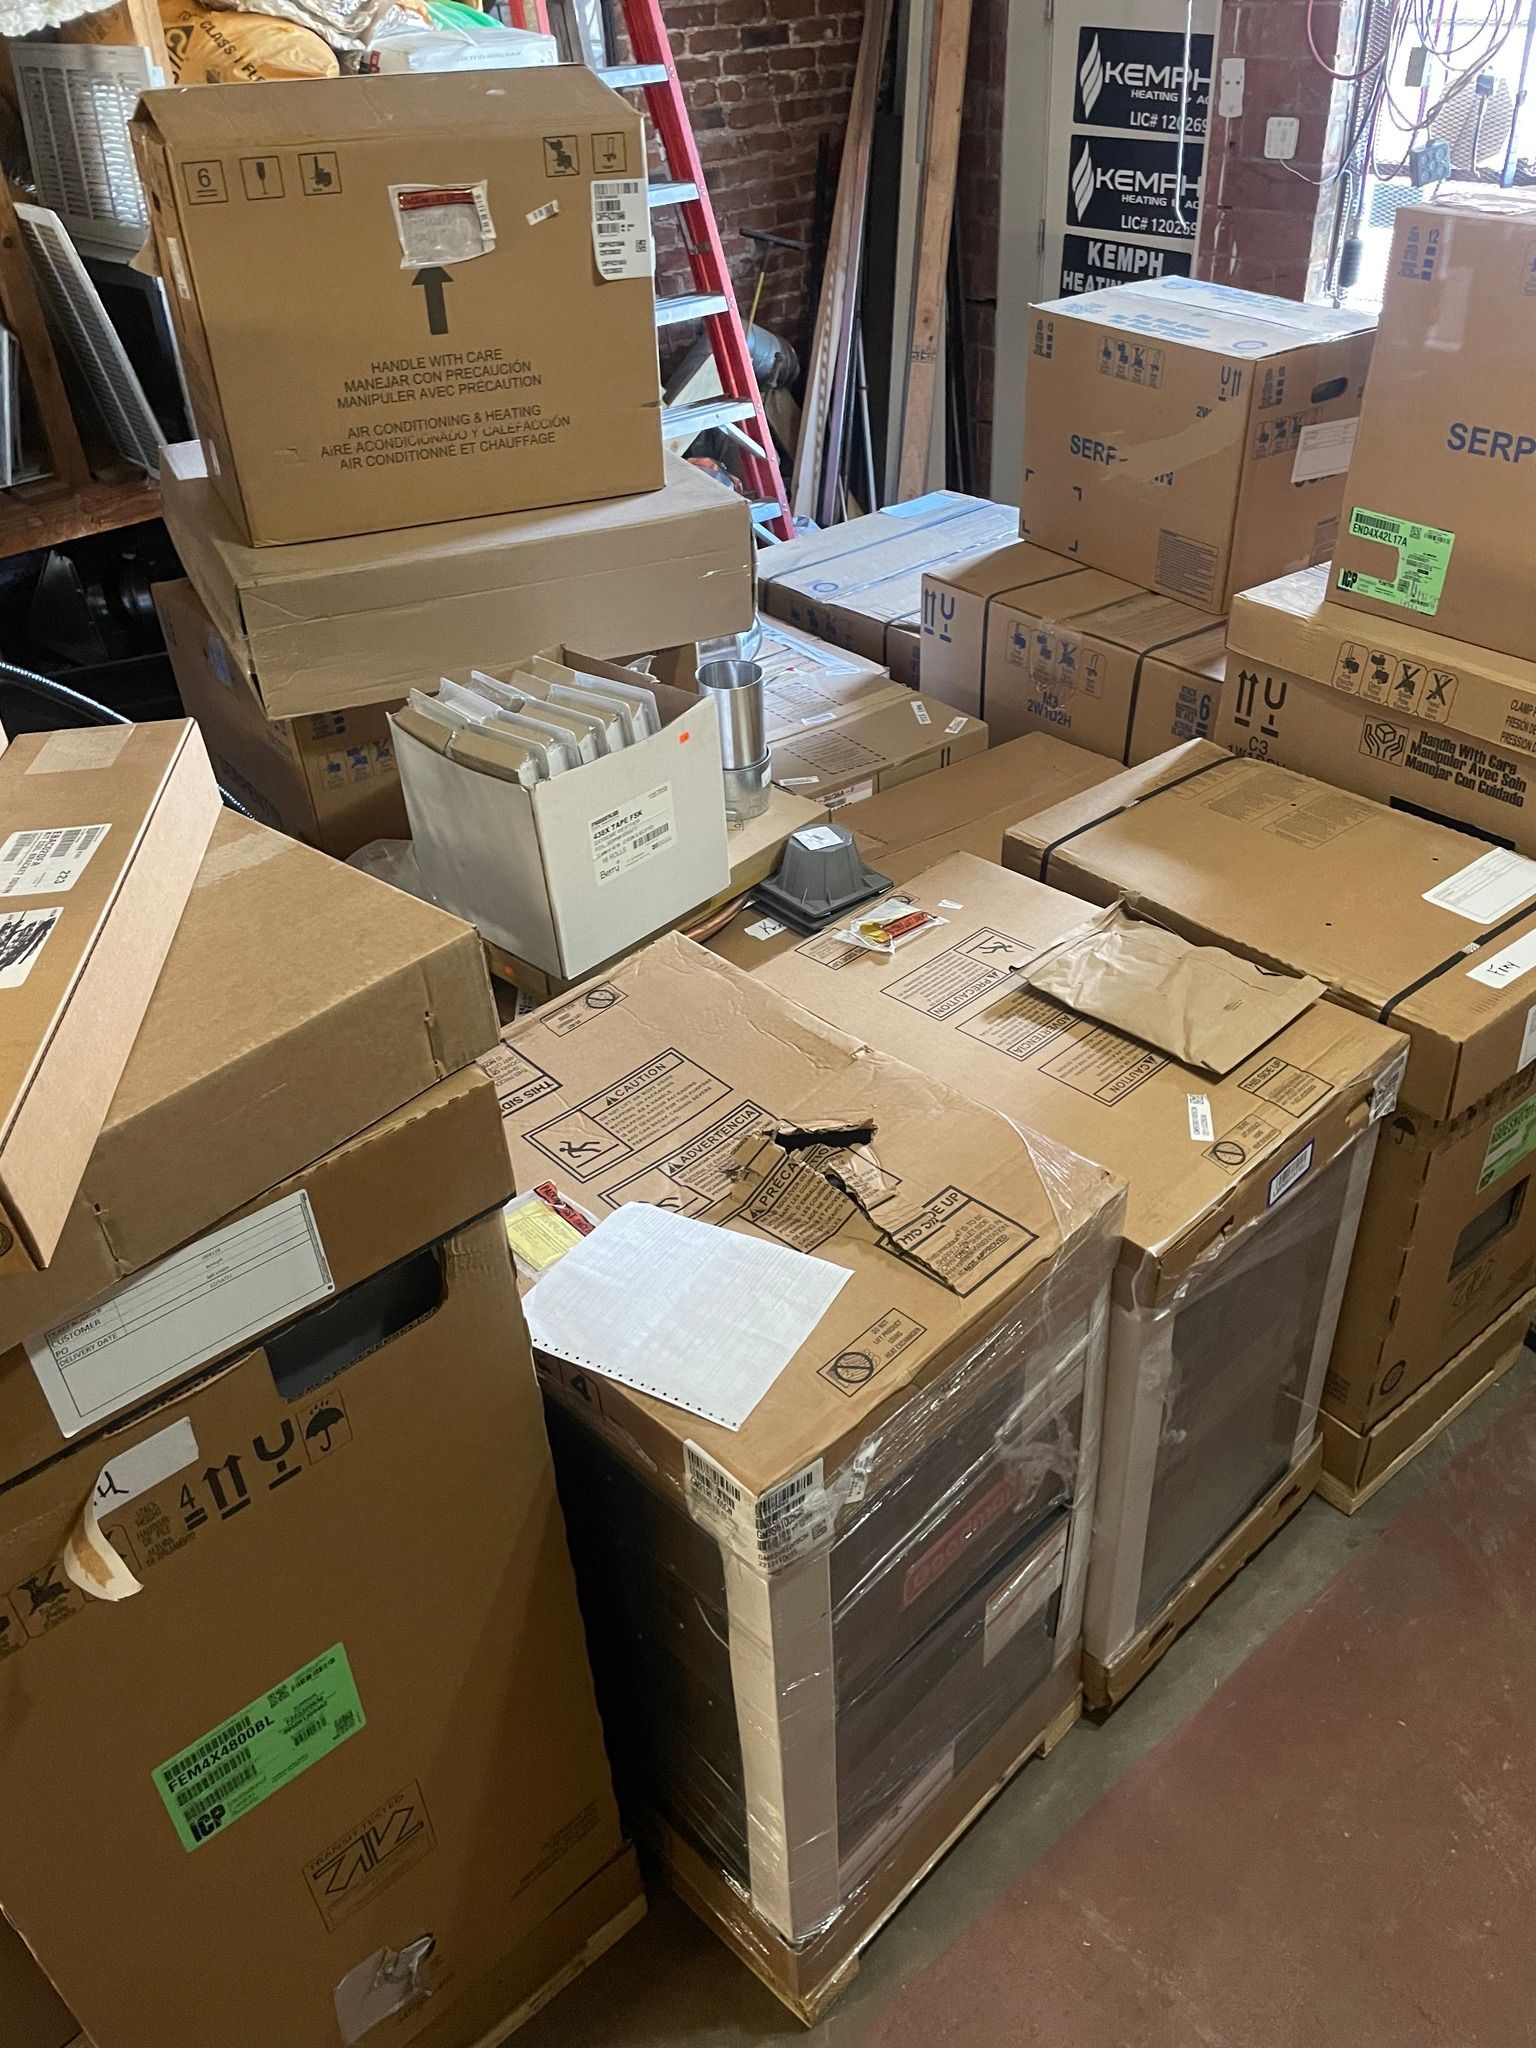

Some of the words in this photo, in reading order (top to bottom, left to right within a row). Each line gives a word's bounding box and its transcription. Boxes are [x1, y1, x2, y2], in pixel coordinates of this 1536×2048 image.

[1104, 61, 1211, 91] KEMPH
[1131, 89, 1178, 103] HEATING
[1130, 111, 1158, 128] LIC#
[196, 168, 212, 188] 6
[1096, 167, 1201, 197] KEMPH
[1121, 194, 1167, 207] HEATING
[1121, 214, 1149, 231] LIC#
[1428, 228, 1441, 245] 12
[1087, 241, 1164, 277] KEMPH
[371, 357, 426, 374] HANDLE
[431, 353, 463, 367] WITH
[467, 348, 503, 363] CARE
[344, 371, 410, 393] MANEJAR
[413, 369, 443, 385] CON
[446, 360, 532, 382] PRECAUCIÓN
[336, 389, 415, 409] MANIPULER
[419, 385, 455, 400] AVEC
[347, 425, 370, 439] AIR
[374, 413, 471, 436] CONDITIONING
[473, 410, 482, 423] &
[485, 404, 542, 421] HEATING
[320, 444, 351, 458] AIRE
[356, 428, 468, 453] ACONDICIONADO
[471, 428, 478, 440] Y
[340, 458, 362, 470] AIR
[460, 442, 476, 454] ET
[480, 431, 556, 452] CHAUFFAGE
[1200, 694, 1211, 721] 6
[1510, 699, 1533, 717] CLAMP
[1248, 736, 1269, 756] C3
[1419, 730, 1456, 756] Handle
[1459, 743, 1486, 765] With
[1487, 754, 1518, 776] Care
[1411, 741, 1467, 770] Manipuler
[1468, 763, 1499, 783] Avec
[1501, 772, 1527, 794] Soin
[1404, 755, 1453, 781] Manejar
[1454, 772, 1477, 790] Con
[1478, 780, 1525, 808] Cuidado
[612, 818, 628, 829] TAPE
[629, 810, 643, 820] FSK
[599, 864, 620, 879] Berry
[1012, 1014, 1072, 1054] ADVERTENCIA
[521, 1078, 554, 1099] THIS
[612, 1062, 668, 1097] CAUTION
[1107, 1062, 1152, 1093] CAUTION
[1242, 1077, 1261, 1090] THIS
[1255, 1066, 1275, 1079] SIDE
[603, 1105, 636, 1125] STRAPPING
[642, 1081, 675, 1101] PACKAGING
[614, 1113, 647, 1133] STRAPPING
[665, 1081, 698, 1101] PACKAGING
[649, 1114, 669, 1127] BREAK
[668, 1099, 692, 1115] CAUSING
[690, 1086, 713, 1100] SEVERE
[675, 1093, 689, 1102] THIS
[607, 1107, 620, 1116] NOT
[609, 1112, 636, 1129] MATERIAL
[631, 1127, 661, 1146] PERSONAL
[676, 1108, 758, 1163] ADVERTENCIA
[939, 1191, 962, 1207] UP
[965, 1218, 977, 1226] TO
[973, 1233, 1009, 1260] APPROVED
[51, 1319, 101, 1348] CUSTOMER
[880, 1319, 903, 1337] PRODUCT
[55, 1347, 69, 1358] PO
[59, 1343, 96, 1367] DELIVERY
[97, 1332, 119, 1348] DATE
[180, 1483, 195, 1509] 4
[167, 1714, 276, 1793] FEM4X4800BL
[189, 1802, 226, 1843] ICP
